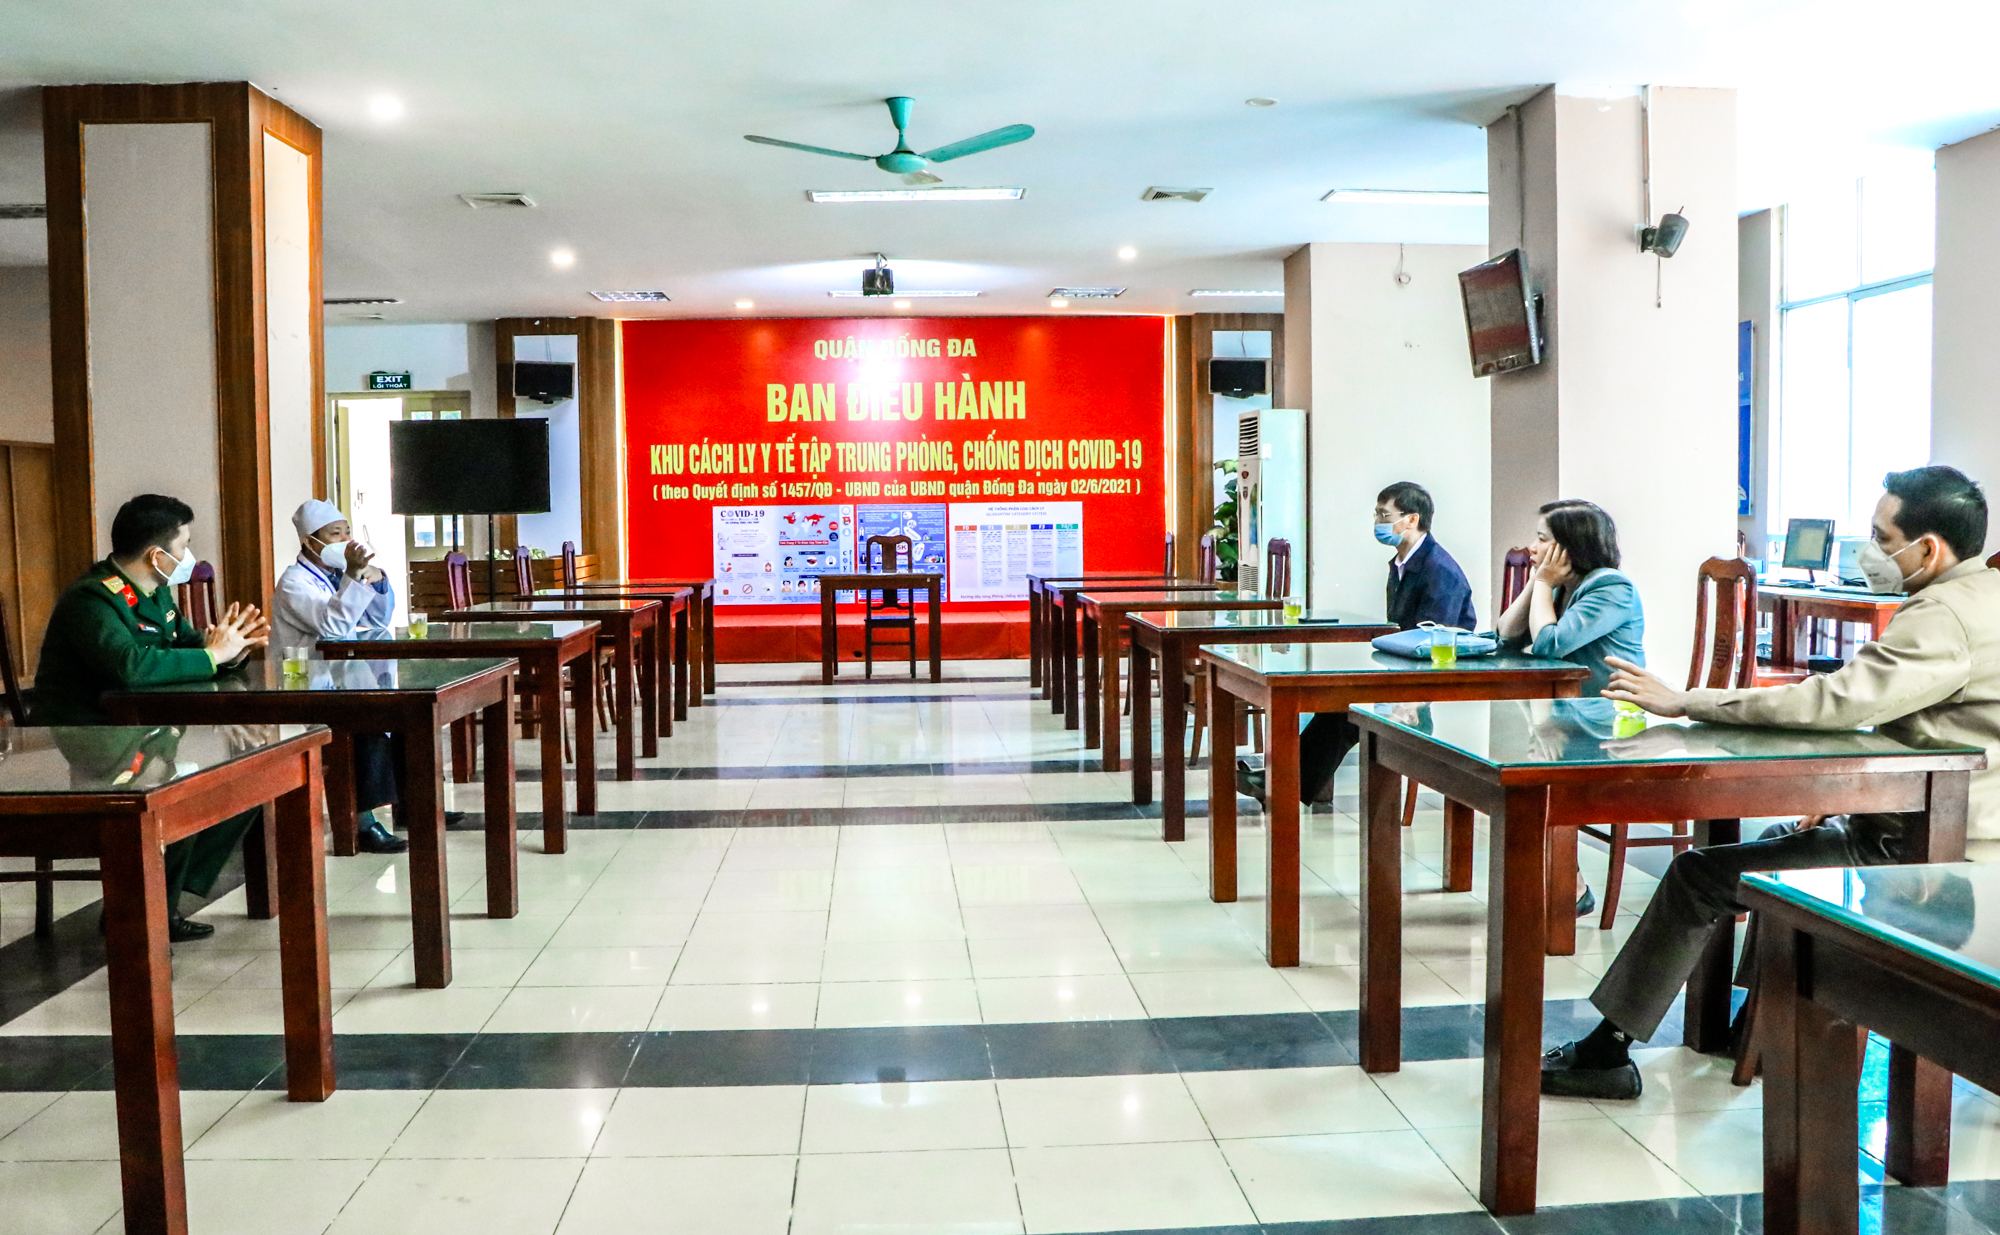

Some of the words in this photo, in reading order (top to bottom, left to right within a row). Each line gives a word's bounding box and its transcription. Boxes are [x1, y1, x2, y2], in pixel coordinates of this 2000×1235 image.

[814, 335, 875, 362] QUẬN
[947, 338, 977, 357] ĐA
[767, 383, 836, 422] BAN
[935, 373, 1026, 420] HÀNH
[650, 444, 684, 475] KHU
[689, 437, 734, 474] CÁCH
[738, 443, 756, 474] LY
[760, 443, 771, 473] Y
[776, 433, 796, 473] TẾ
[799, 436, 832, 480] TẬP
[836, 441, 891, 473] TRUNG
[896, 433, 959, 475] PHÒNG,
[963, 429, 1020, 471] CHỐNG
[1024, 439, 1063, 477] DỊCH
[1067, 439, 1142, 470] COVID-19
[653, 484, 658, 501] (
[661, 484, 689, 500] theo
[692, 480, 728, 501] Quyết
[731, 482, 759, 502] định
[762, 480, 778, 499] số
[780, 482, 833, 499] 1457/QĐ
[845, 481, 880, 497] UBND
[884, 479, 907, 497] của
[910, 480, 946, 497] UBND
[949, 480, 980, 499] quận
[983, 477, 1015, 497] Đống
[1018, 479, 1034, 495] Đa
[1038, 478, 1068, 497] ngày
[1071, 478, 1131, 495] 02/6/2021
[1135, 478, 1141, 495] )
[720, 509, 765, 518] COVID-19
